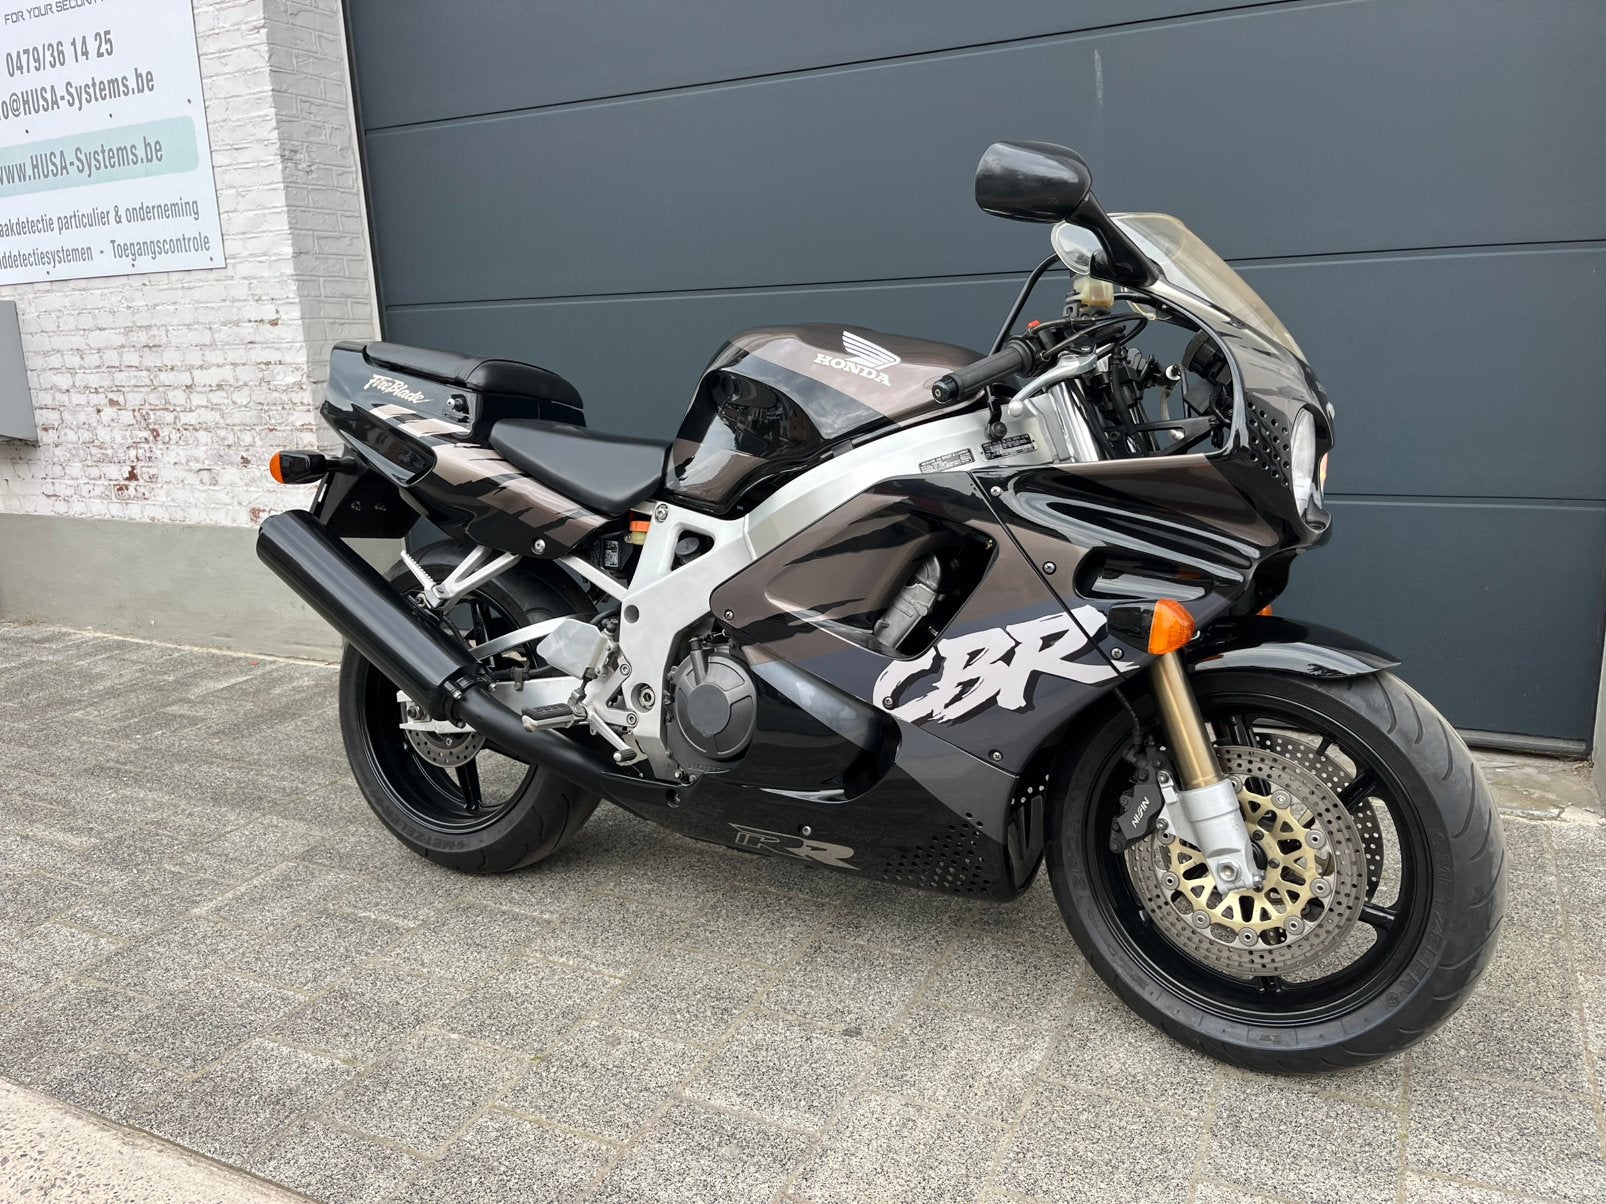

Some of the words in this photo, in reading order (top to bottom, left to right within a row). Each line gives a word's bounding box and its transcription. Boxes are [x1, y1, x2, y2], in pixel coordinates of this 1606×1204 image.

[4, 11, 25, 25] FOR
[26, 3, 54, 19] YOUR
[55, 0, 103, 12] SECU
[6, 40, 66, 78] 0479/36
[71, 35, 89, 63] 14
[94, 30, 114, 58] 25
[0, 67, 154, 120] o@HUSA-Systems.be
[57, 207, 110, 235] particulier
[114, 205, 122, 224] &
[125, 197, 199, 224] onderneming
[110, 232, 210, 260] Toegangscontrole
[813, 353, 891, 387] HONDA
[872, 604, 1141, 725] CBR
